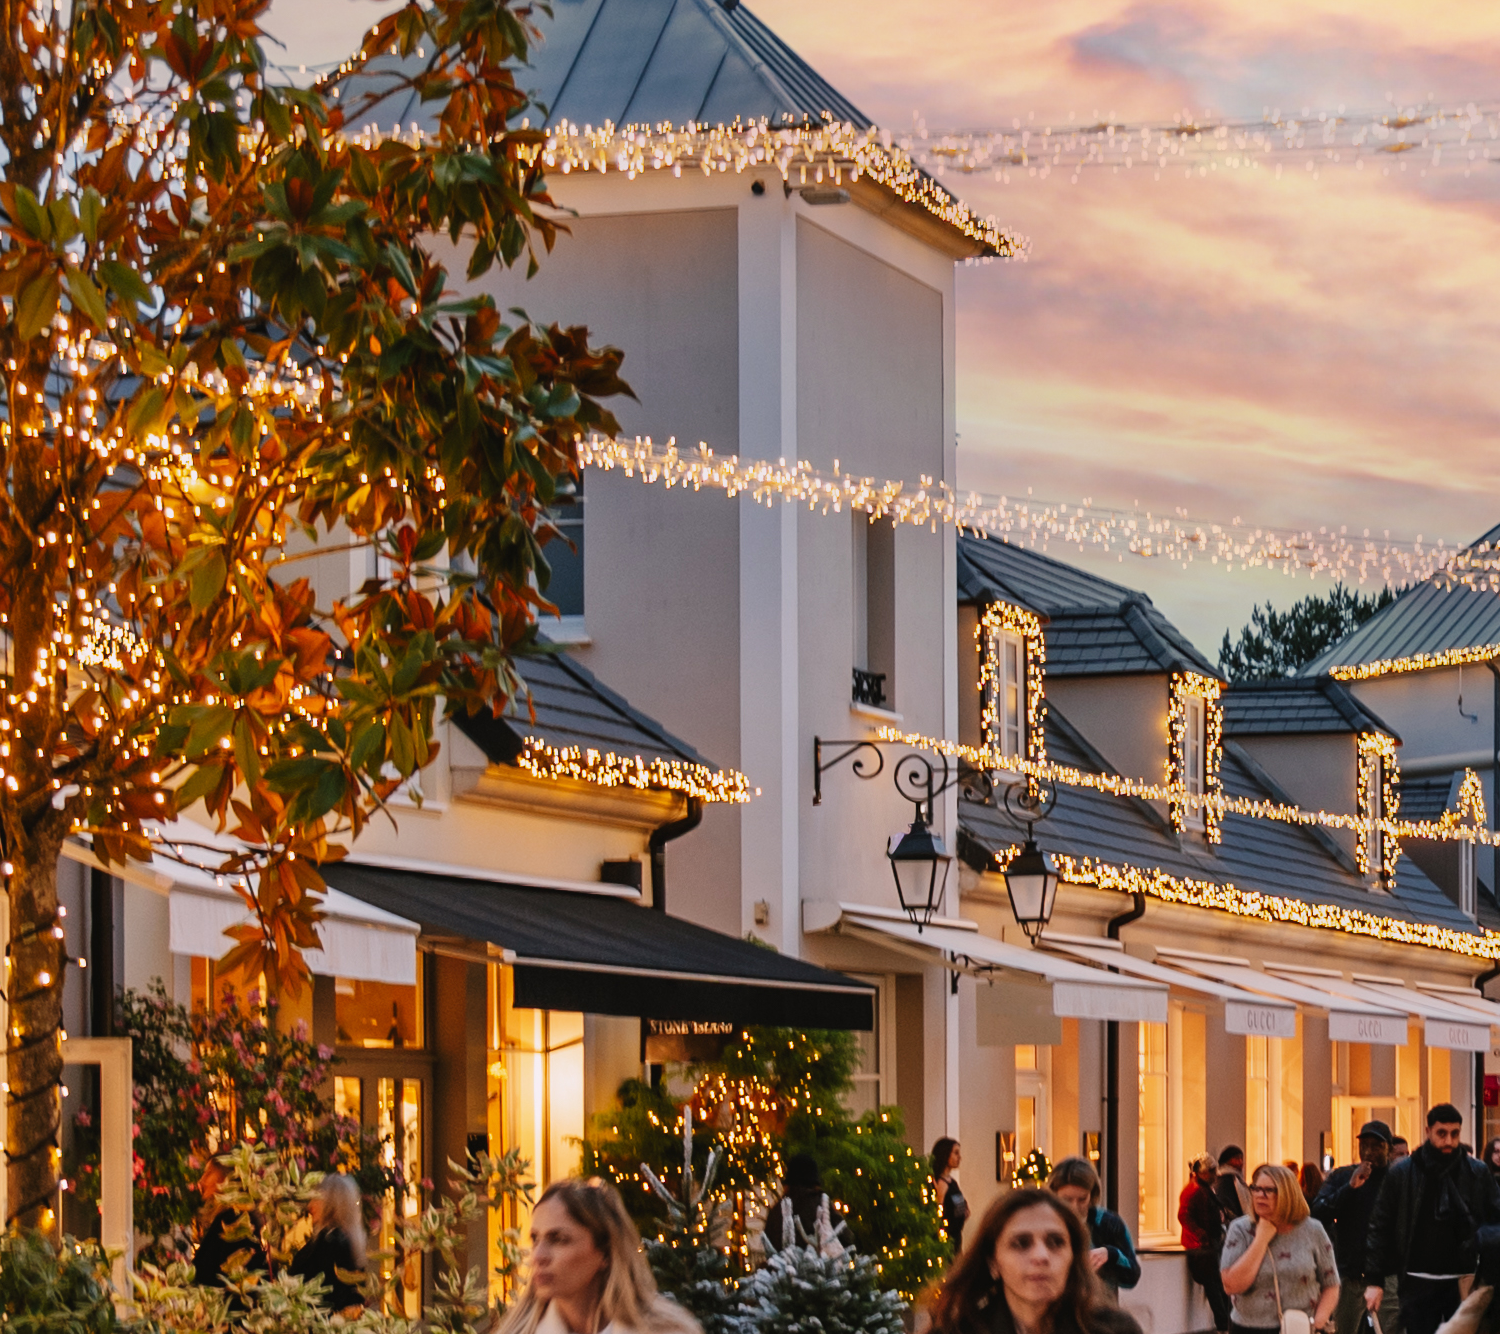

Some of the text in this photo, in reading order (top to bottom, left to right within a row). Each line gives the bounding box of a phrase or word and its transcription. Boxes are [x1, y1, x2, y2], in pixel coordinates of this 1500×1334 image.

[650, 1019, 733, 1035] STONE ISLAND
[1247, 1009, 1276, 1030] GUCCI
[1358, 1019, 1383, 1039] GUCCI
[1449, 1027, 1469, 1045] GUCCI
